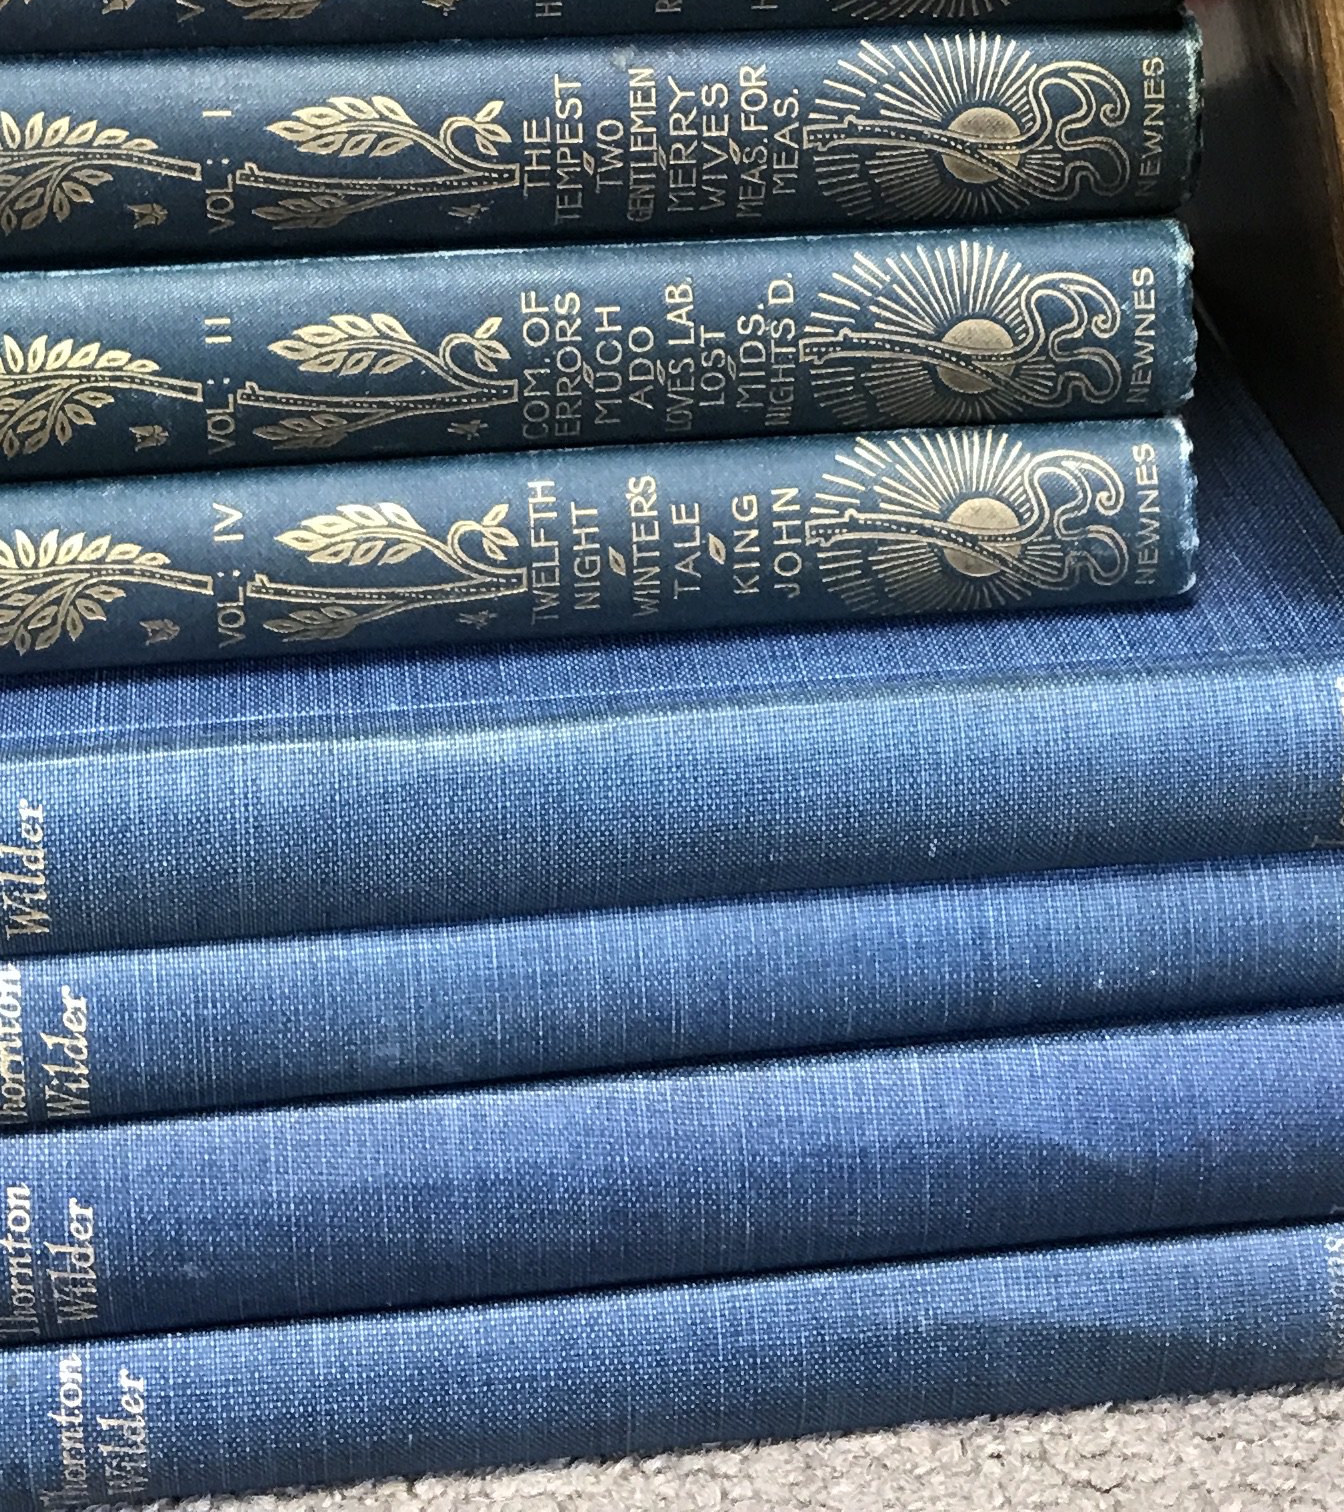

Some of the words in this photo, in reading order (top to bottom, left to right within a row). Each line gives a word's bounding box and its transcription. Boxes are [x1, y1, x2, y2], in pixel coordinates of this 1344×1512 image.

[554, 74, 583, 223] TEMPEST
[627, 67, 656, 222] GENTLEMEN
[668, 75, 697, 212] MERRY
[699, 82, 729, 212] WIVES
[740, 64, 767, 130] FOR
[773, 88, 799, 194] MEAS.
[1136, 56, 1166, 195] NEWNES
[523, 117, 551, 196] THE
[596, 118, 623, 193] TWO
[737, 136, 768, 218] MEAS.
[204, 316, 232, 344] II
[520, 291, 549, 347] OF
[664, 276, 693, 344] LAB.
[768, 273, 796, 303] D.
[1127, 267, 1155, 403] NEWNES
[522, 356, 550, 439] COM.
[555, 291, 581, 438] ERRORS
[594, 306, 622, 424] MUCH
[628, 326, 654, 408] ADO
[698, 325, 724, 408] LOST
[736, 303, 764, 408] MIDS.
[212, 502, 245, 542] IV
[527, 480, 559, 625] TWELFTH
[572, 501, 601, 609] NIGHT
[671, 500, 701, 598] TALE
[732, 493, 759, 594] KING
[772, 487, 801, 598] JOHN
[1135, 442, 1160, 585] NEWNES
[40, 984, 91, 1118] Wilder
[44, 1195, 98, 1324] Wilder
[96, 1367, 148, 1496] Wilder
